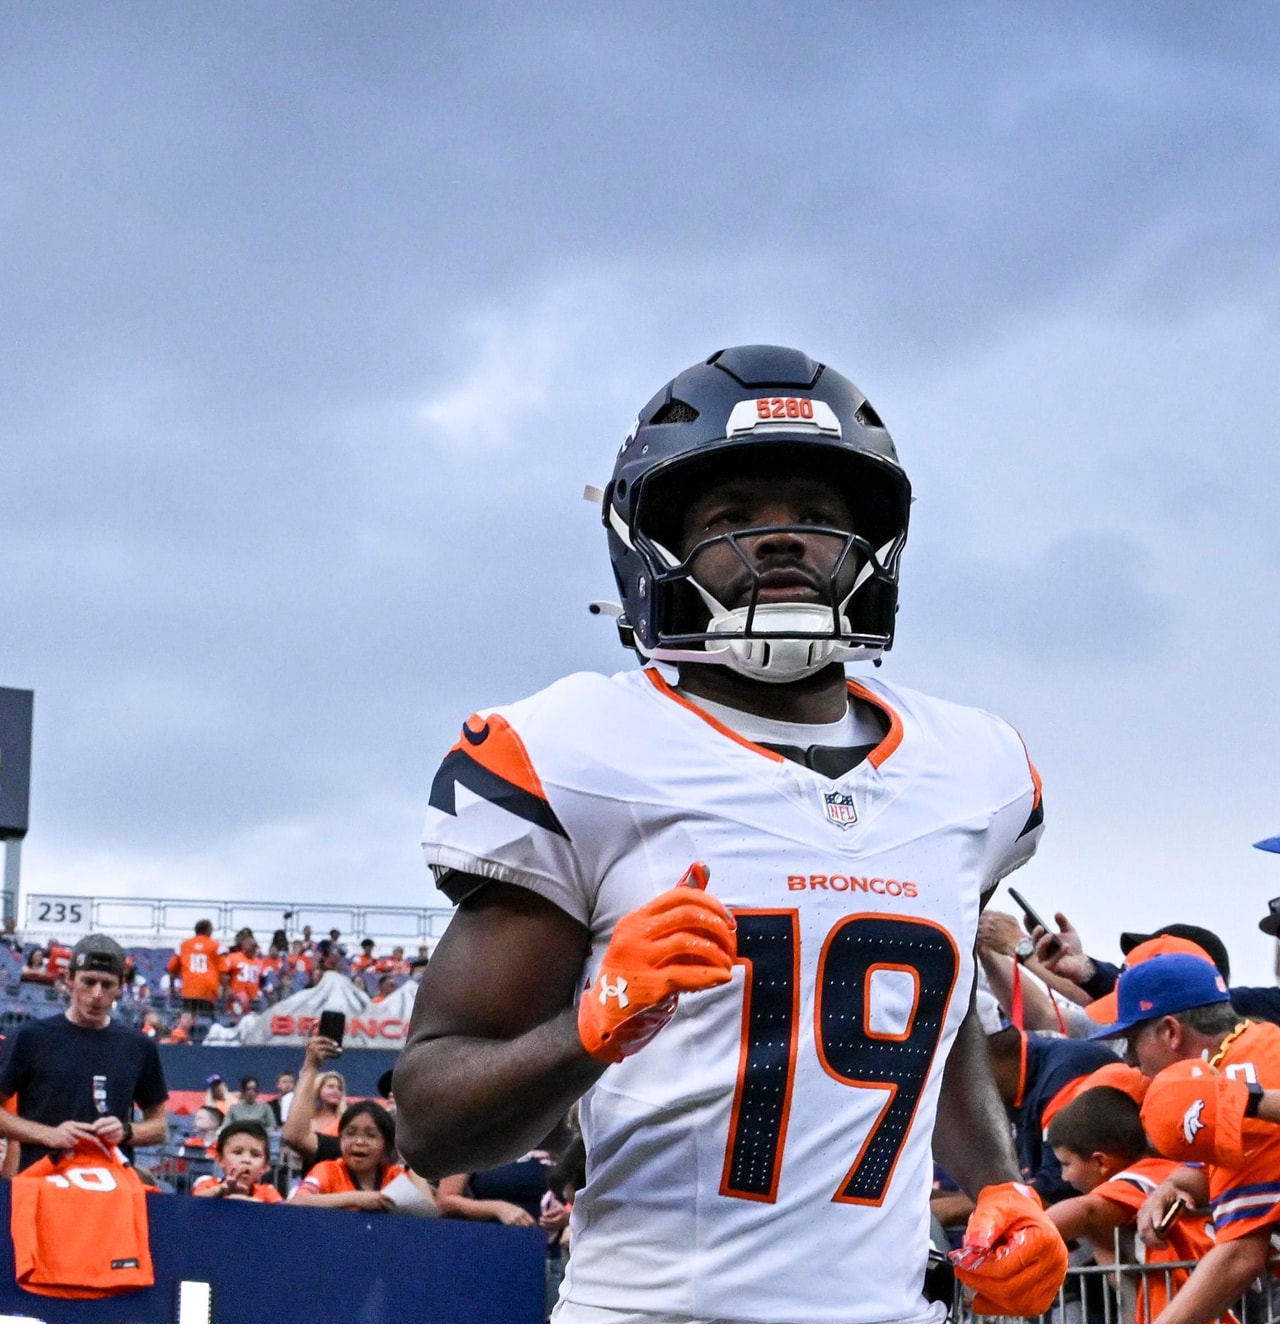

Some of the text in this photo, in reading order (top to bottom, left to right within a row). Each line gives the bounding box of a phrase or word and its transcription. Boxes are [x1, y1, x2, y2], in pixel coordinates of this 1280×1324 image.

[756, 398, 814, 419] 5280
[829, 804, 855, 822] NFL
[787, 874, 918, 898] BRONCOS
[37, 901, 83, 925] 235
[271, 1015, 410, 1039] BRNC
[720, 906, 961, 1208] 19
